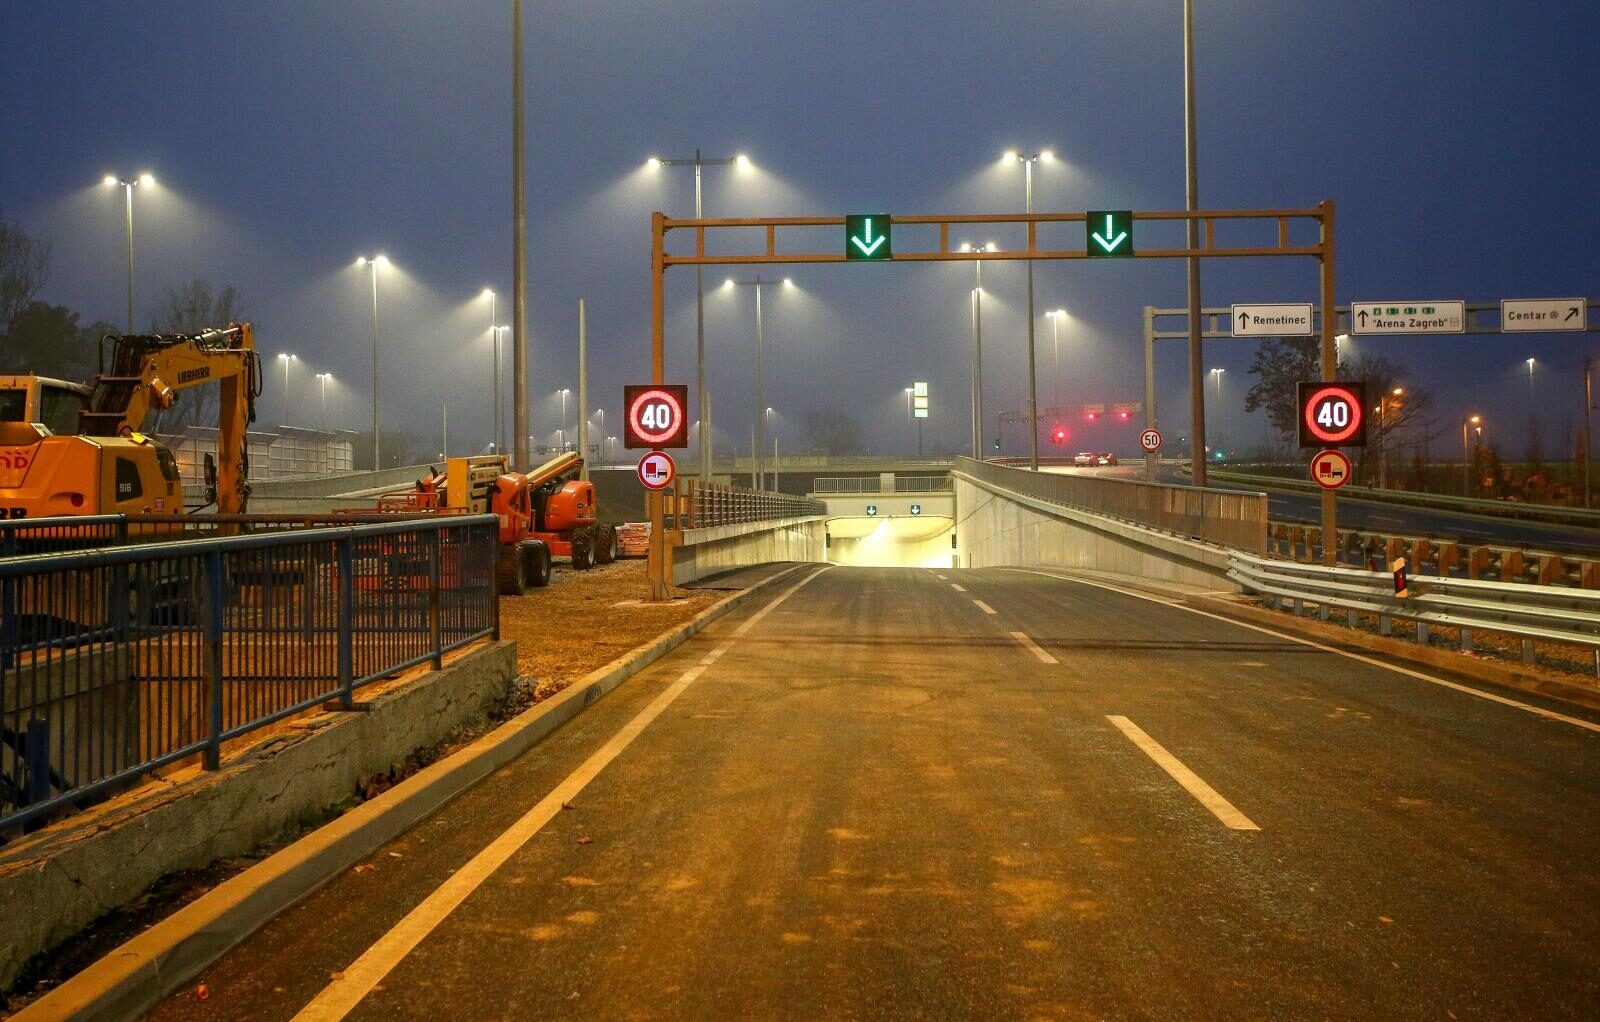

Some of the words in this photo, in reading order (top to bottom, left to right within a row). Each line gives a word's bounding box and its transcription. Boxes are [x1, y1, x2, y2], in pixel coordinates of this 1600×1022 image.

[1253, 315, 1306, 325] Remetinec
[1508, 311, 1547, 320] Centar
[1373, 319, 1405, 328] "Arena
[1409, 318, 1448, 329] Zagreb"
[641, 404, 670, 429] 40
[1317, 401, 1348, 427] 40
[1144, 434, 1158, 446] 50
[119, 482, 132, 493] 916
